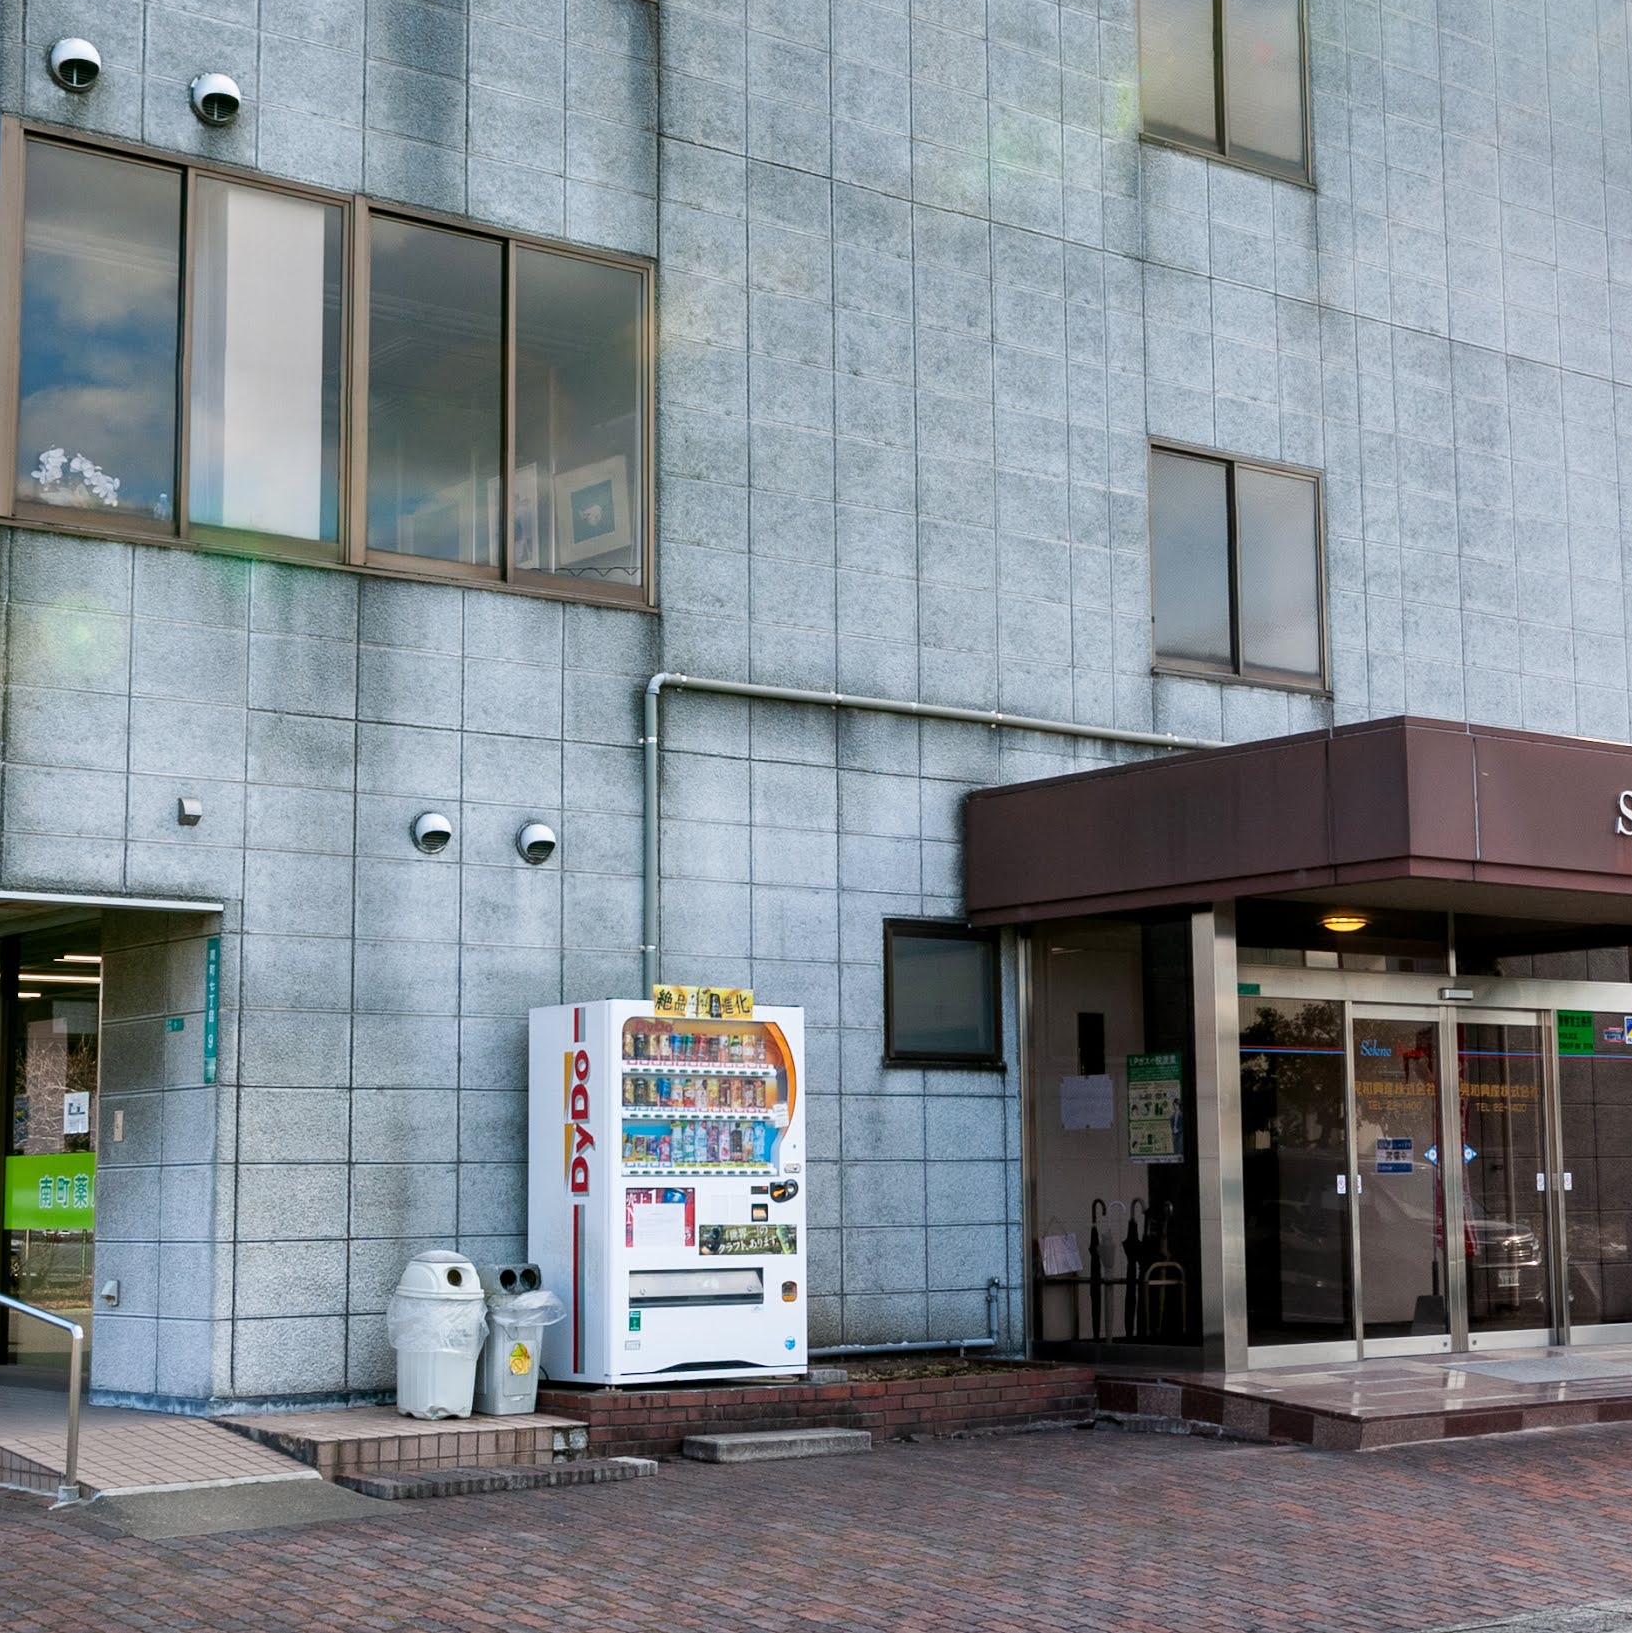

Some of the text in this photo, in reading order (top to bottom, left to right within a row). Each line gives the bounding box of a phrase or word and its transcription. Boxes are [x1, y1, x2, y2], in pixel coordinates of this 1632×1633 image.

[655, 989, 752, 1014] 絶品 進化
[39, 1173, 95, 1209] 南町薬
